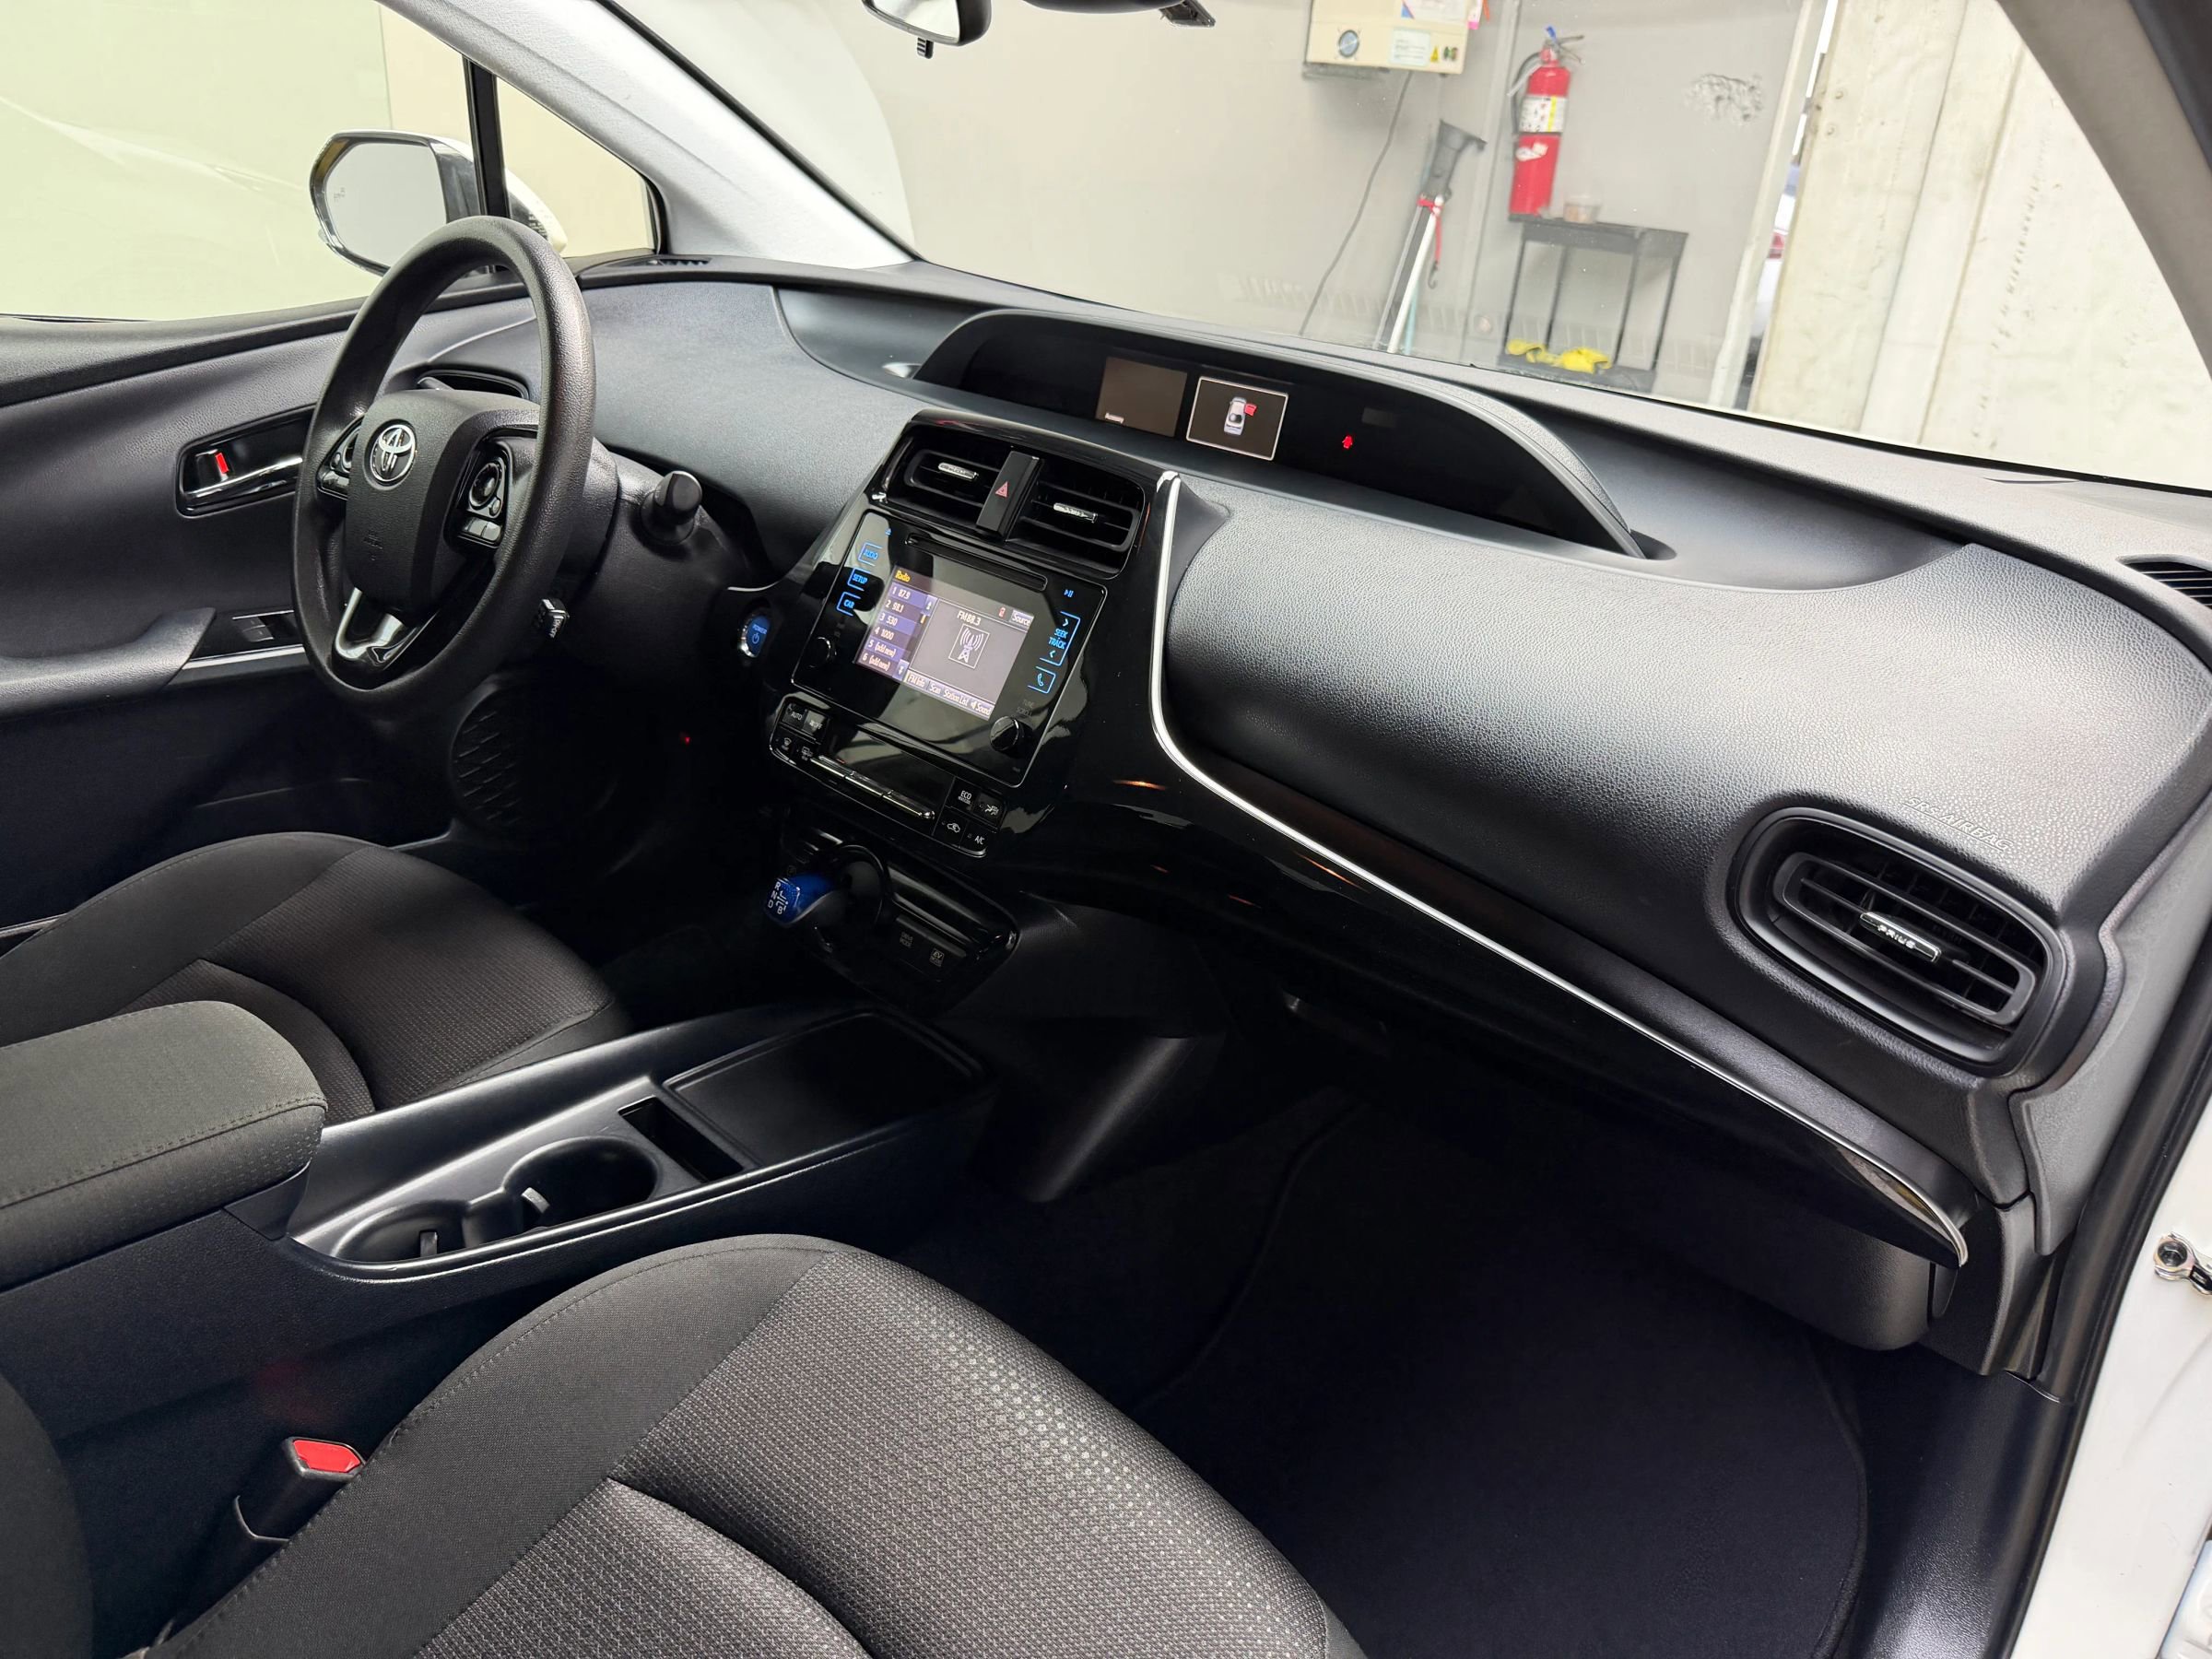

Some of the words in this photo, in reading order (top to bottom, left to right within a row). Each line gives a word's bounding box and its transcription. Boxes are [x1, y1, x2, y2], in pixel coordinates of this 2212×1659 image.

[852, 572, 868, 584] SETUP
[895, 570, 911, 582] Radio
[843, 599, 855, 609] CAR
[885, 599, 891, 608] 2
[879, 612, 886, 621] 3
[886, 615, 899, 627] 530
[1011, 612, 1031, 627] Source
[874, 626, 880, 635] 4
[1053, 628, 1068, 639] SEEK
[867, 640, 874, 648] 5
[1048, 636, 1066, 650] TRACK
[862, 653, 868, 661] 6
[929, 683, 941, 695] Scan
[943, 688, 959, 701] Station
[975, 702, 992, 716] Sound
[790, 711, 803, 721] AUTO
[960, 790, 972, 800] ECO
[1906, 796, 1941, 816] SRS
[1938, 813, 2014, 852] AIRBAG
[974, 835, 985, 845] A/C
[774, 881, 782, 891] R
[771, 889, 778, 900] N
[768, 899, 774, 909] D
[777, 906, 783, 914] B
[1877, 924, 1917, 950] PRIUS
